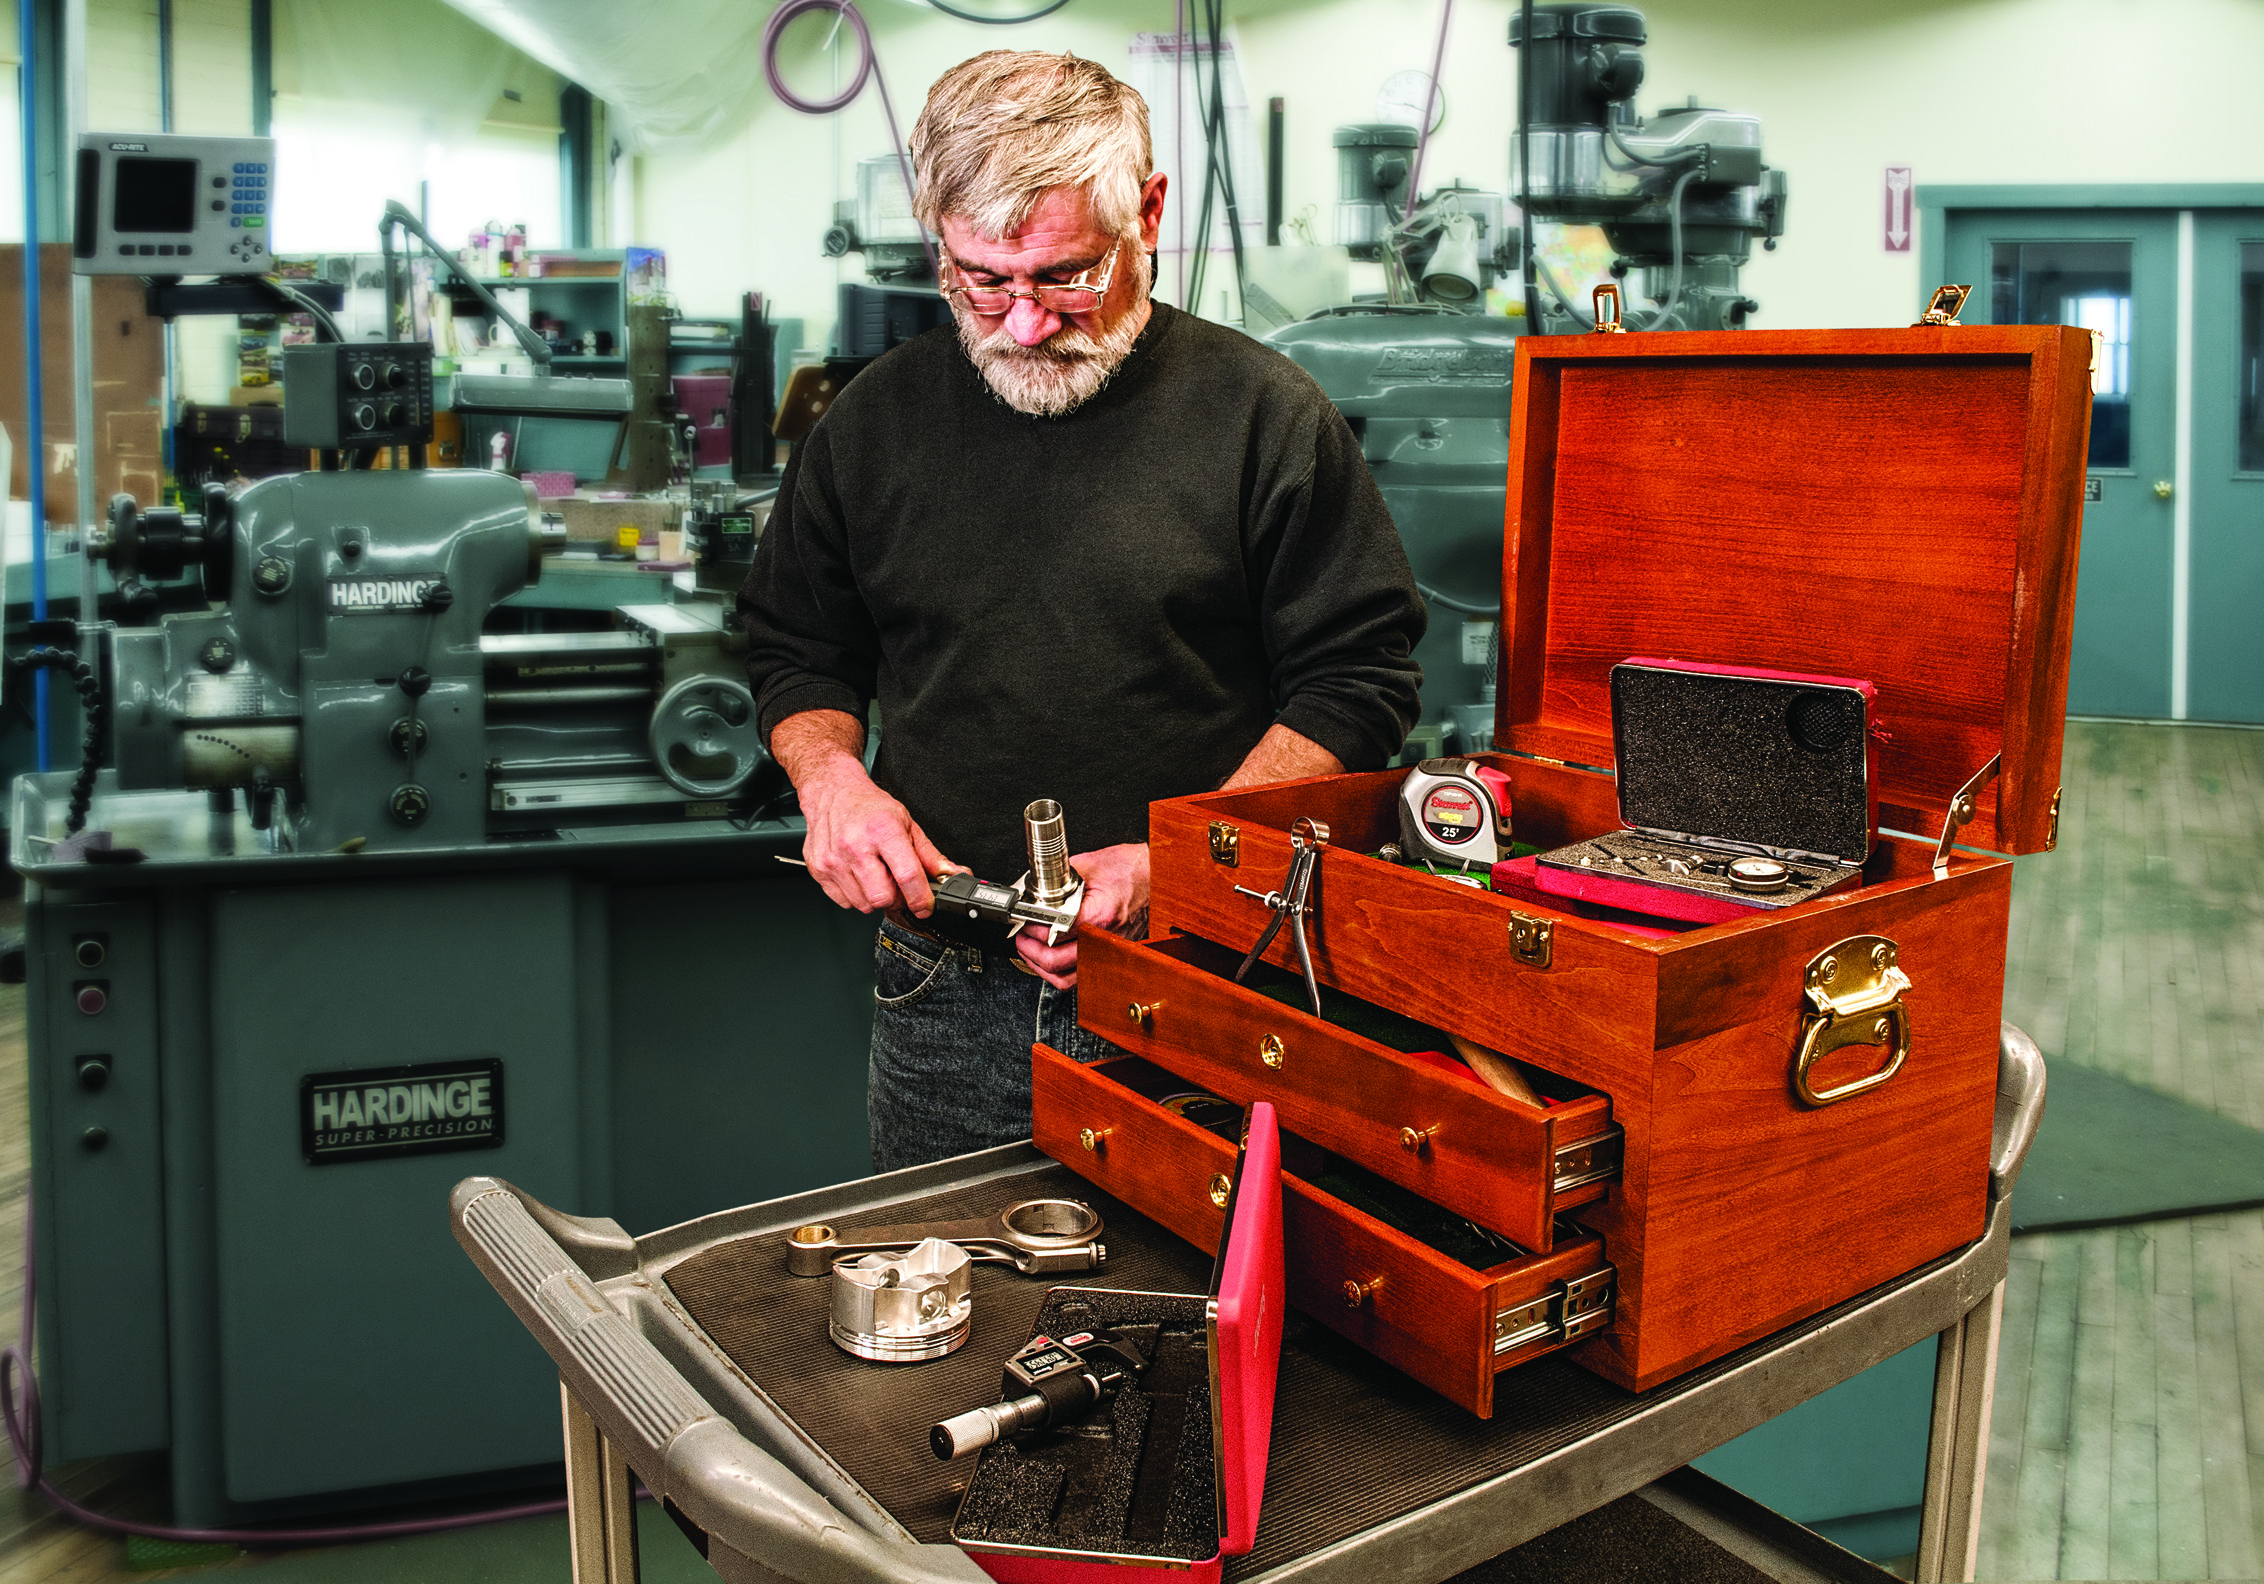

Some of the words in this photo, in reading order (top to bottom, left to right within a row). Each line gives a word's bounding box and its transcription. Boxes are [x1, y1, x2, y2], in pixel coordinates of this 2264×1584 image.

[111, 143, 146, 151] ACU-RITE
[1431, 796, 1472, 811] Starrett
[1442, 827, 1459, 838] 25'
[313, 1078, 492, 1131] HARDINGE
[315, 1119, 493, 1146] SUPER-PRECISION
